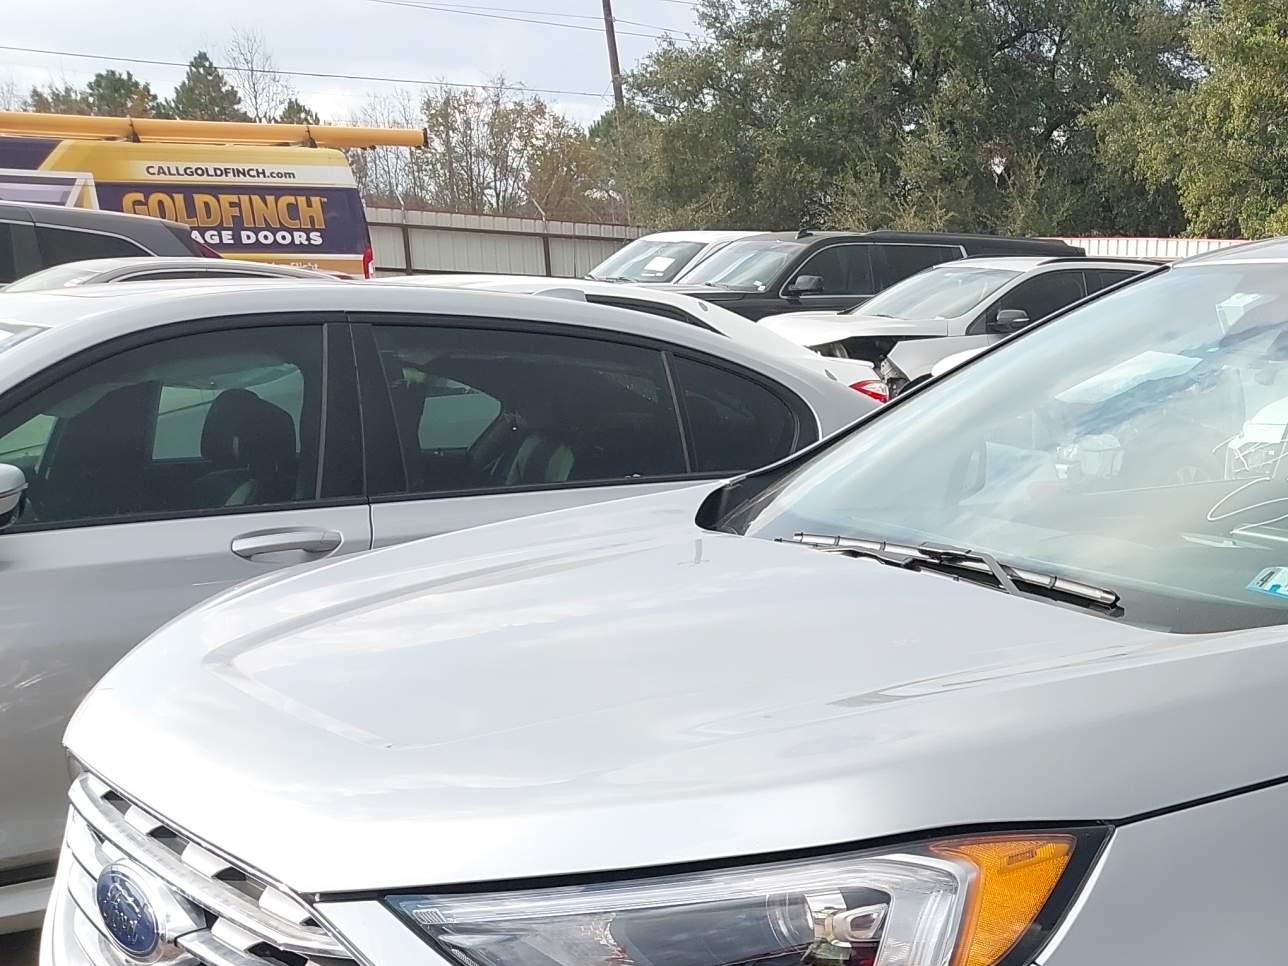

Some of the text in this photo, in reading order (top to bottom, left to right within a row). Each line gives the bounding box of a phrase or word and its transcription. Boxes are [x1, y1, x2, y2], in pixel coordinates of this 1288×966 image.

[145, 165, 296, 179] CALLGOLDFINCH.com
[122, 192, 325, 228] GOLDFINCH
[190, 230, 323, 245] AGE DOORS
